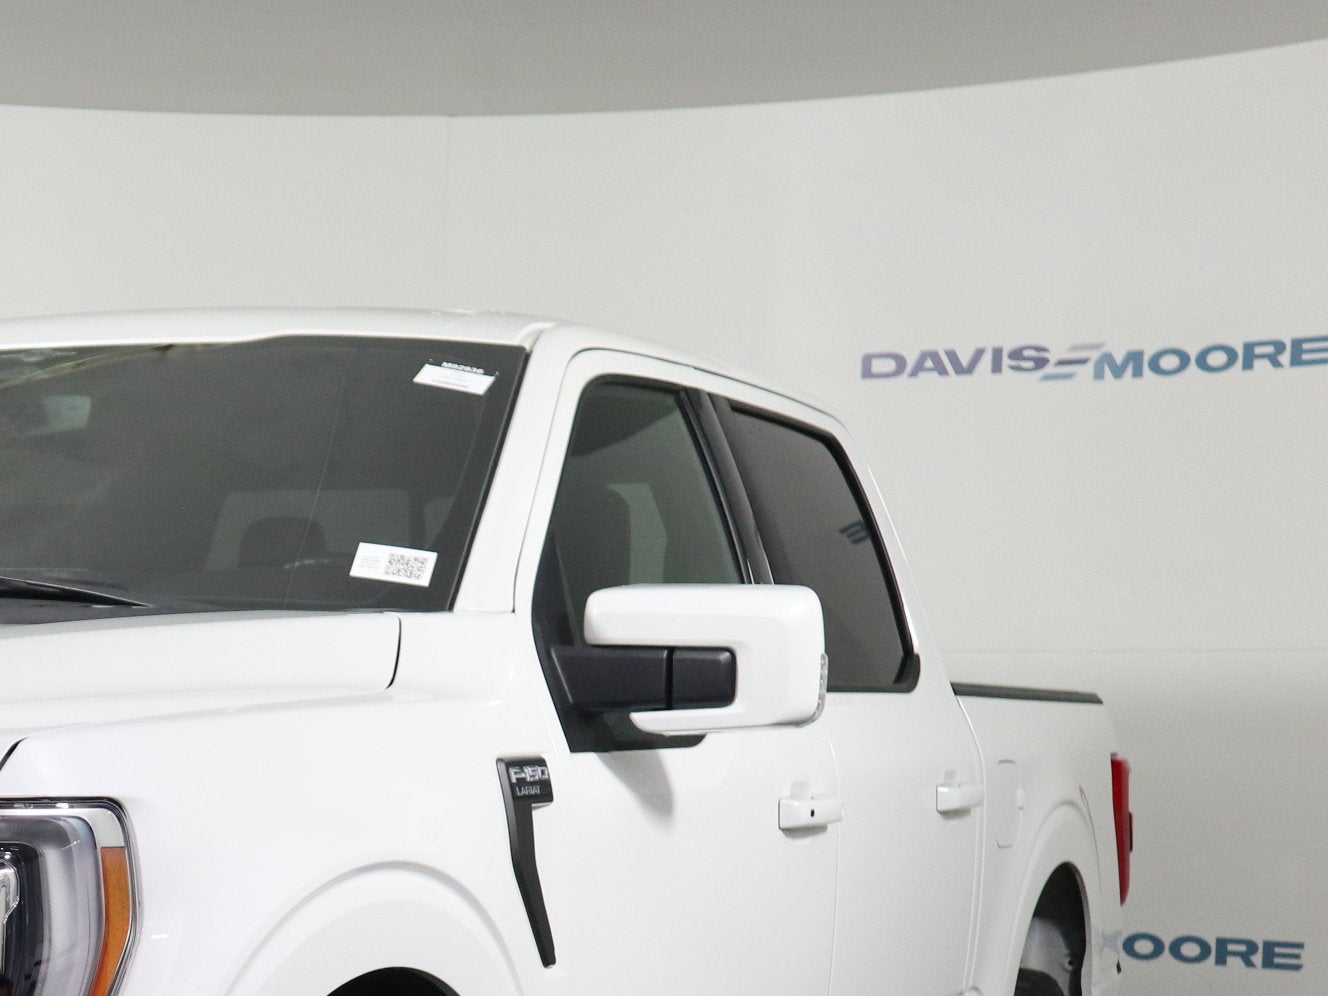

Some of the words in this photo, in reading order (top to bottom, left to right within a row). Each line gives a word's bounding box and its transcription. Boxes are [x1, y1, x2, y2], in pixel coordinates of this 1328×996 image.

[861, 344, 1051, 380] DAVIS
[1092, 334, 1328, 382] MOORE
[509, 765, 549, 783] F-150
[516, 785, 541, 797] LARIAT
